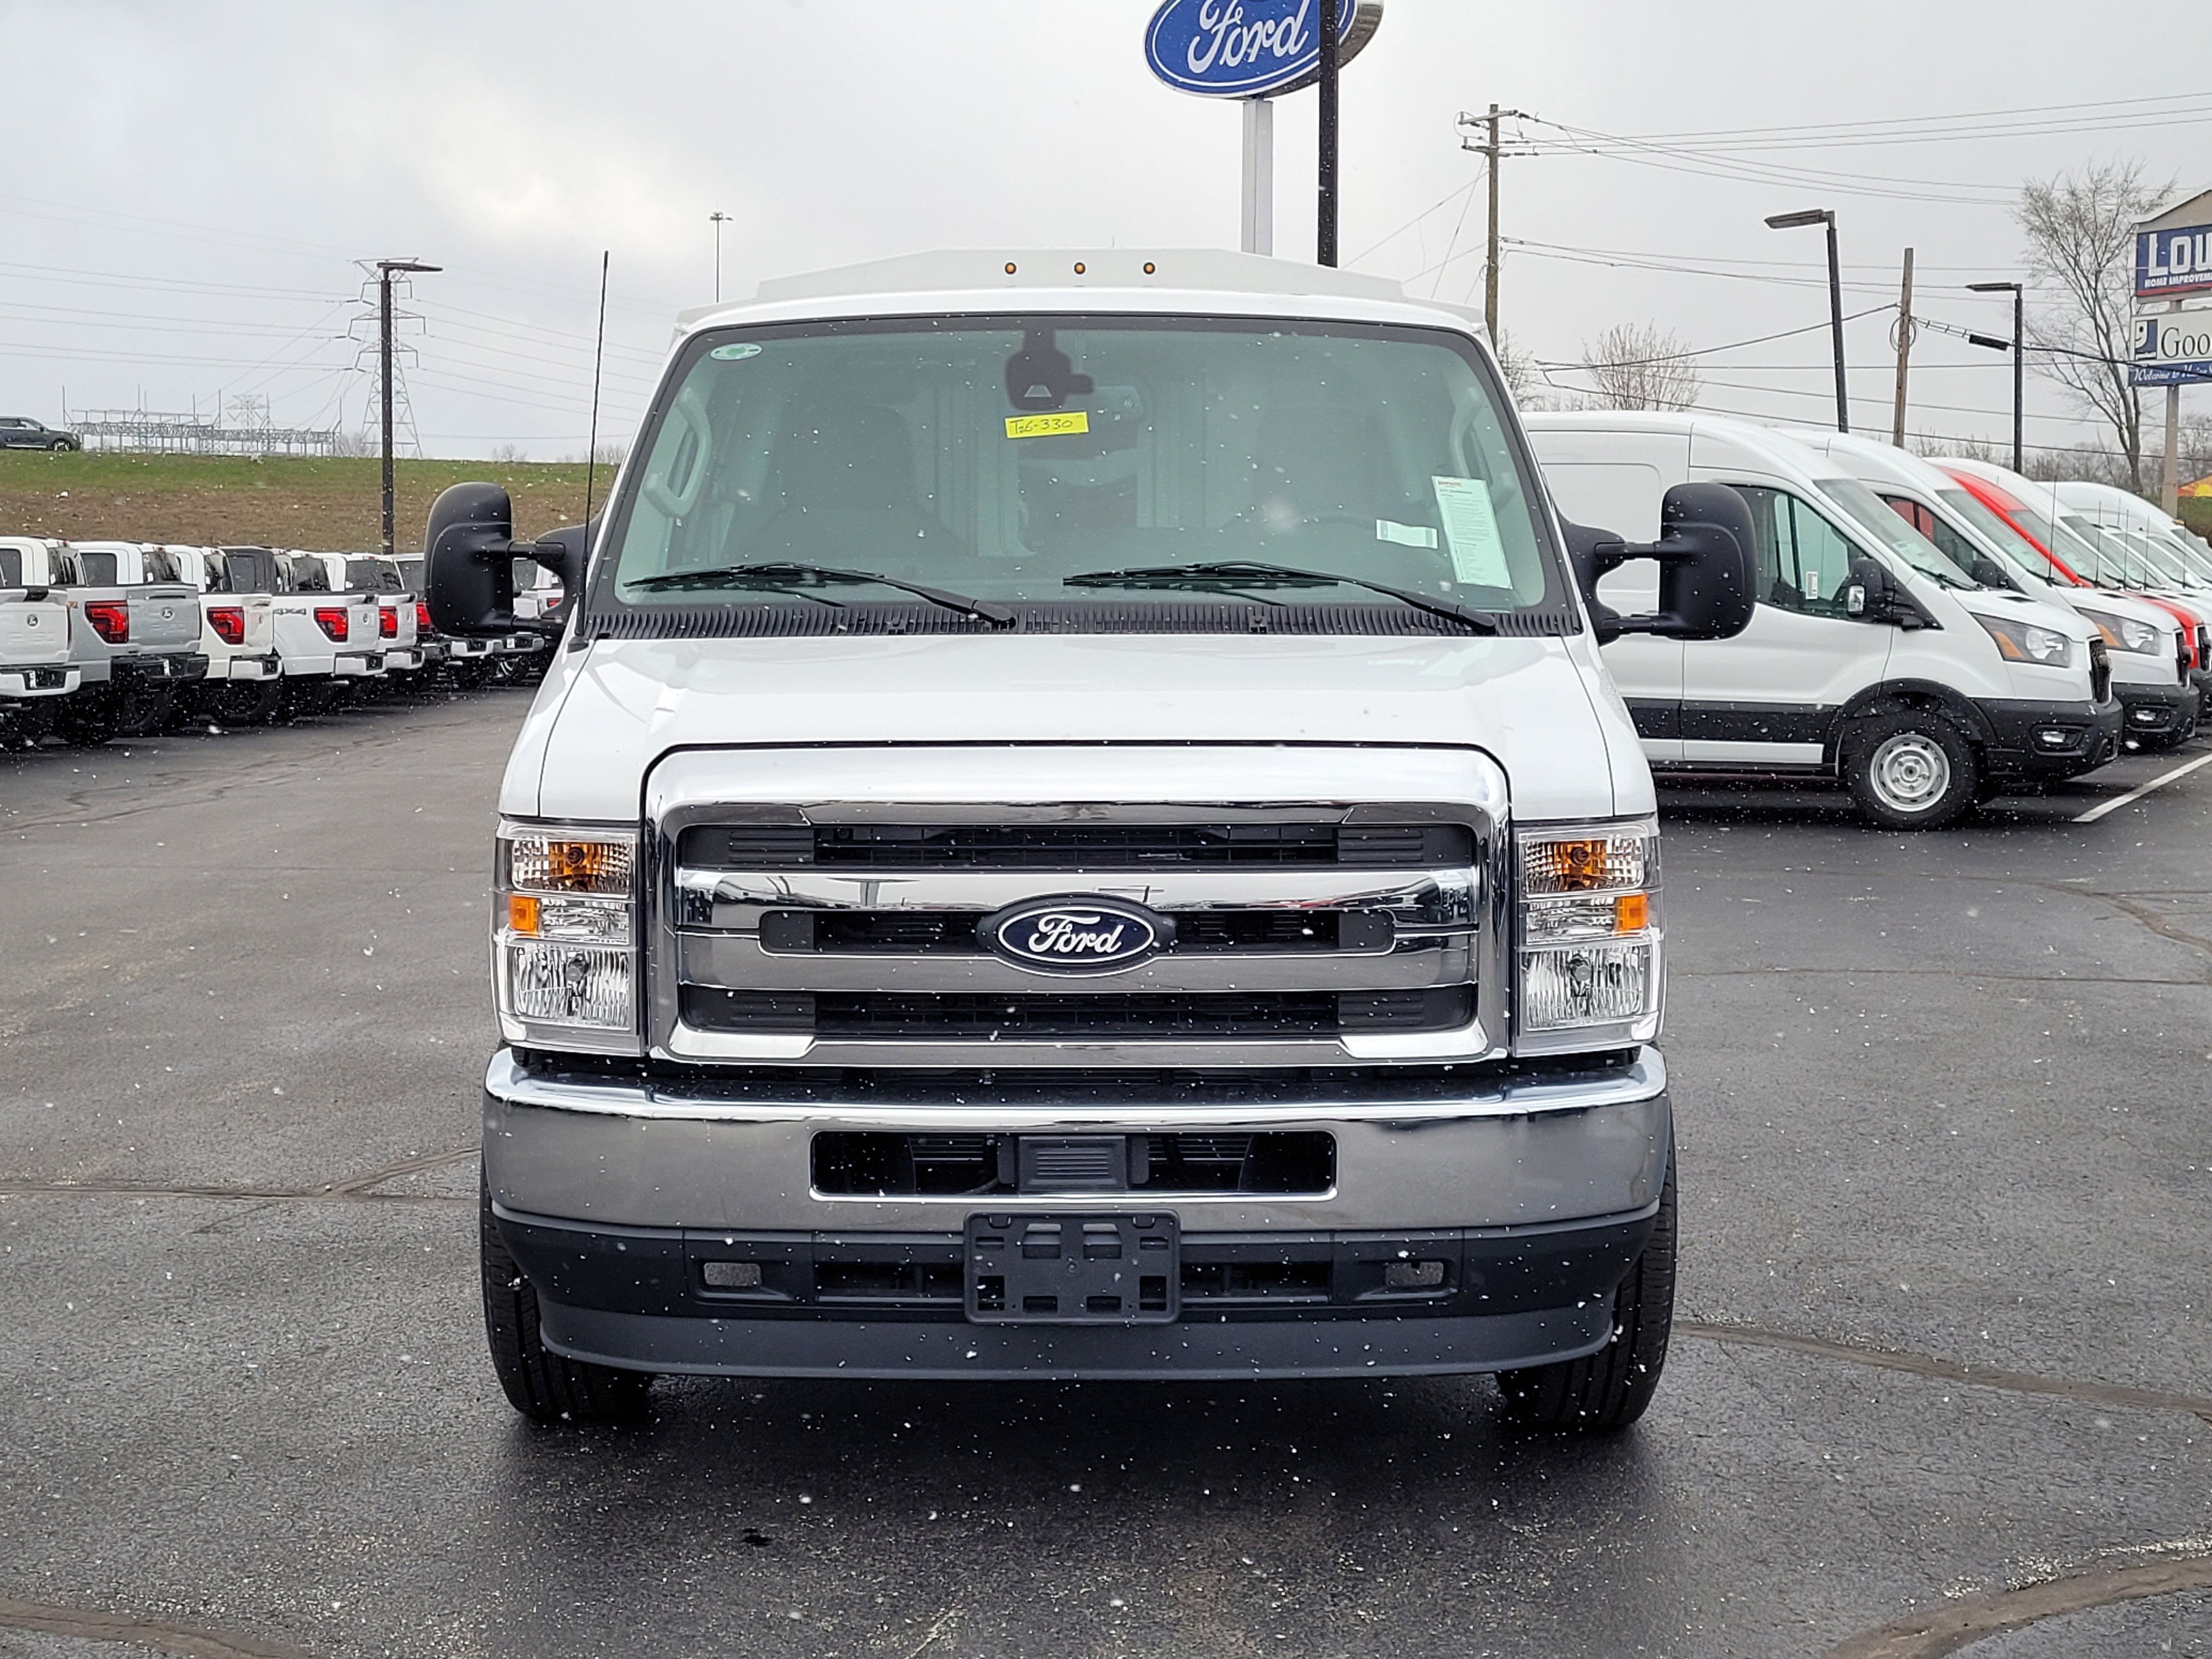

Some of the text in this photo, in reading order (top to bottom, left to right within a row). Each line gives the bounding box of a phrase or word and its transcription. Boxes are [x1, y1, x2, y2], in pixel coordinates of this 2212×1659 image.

[1188, 0, 1309, 74] Ford
[2161, 326, 2210, 358] Goo
[1028, 914, 1124, 952] Ford
